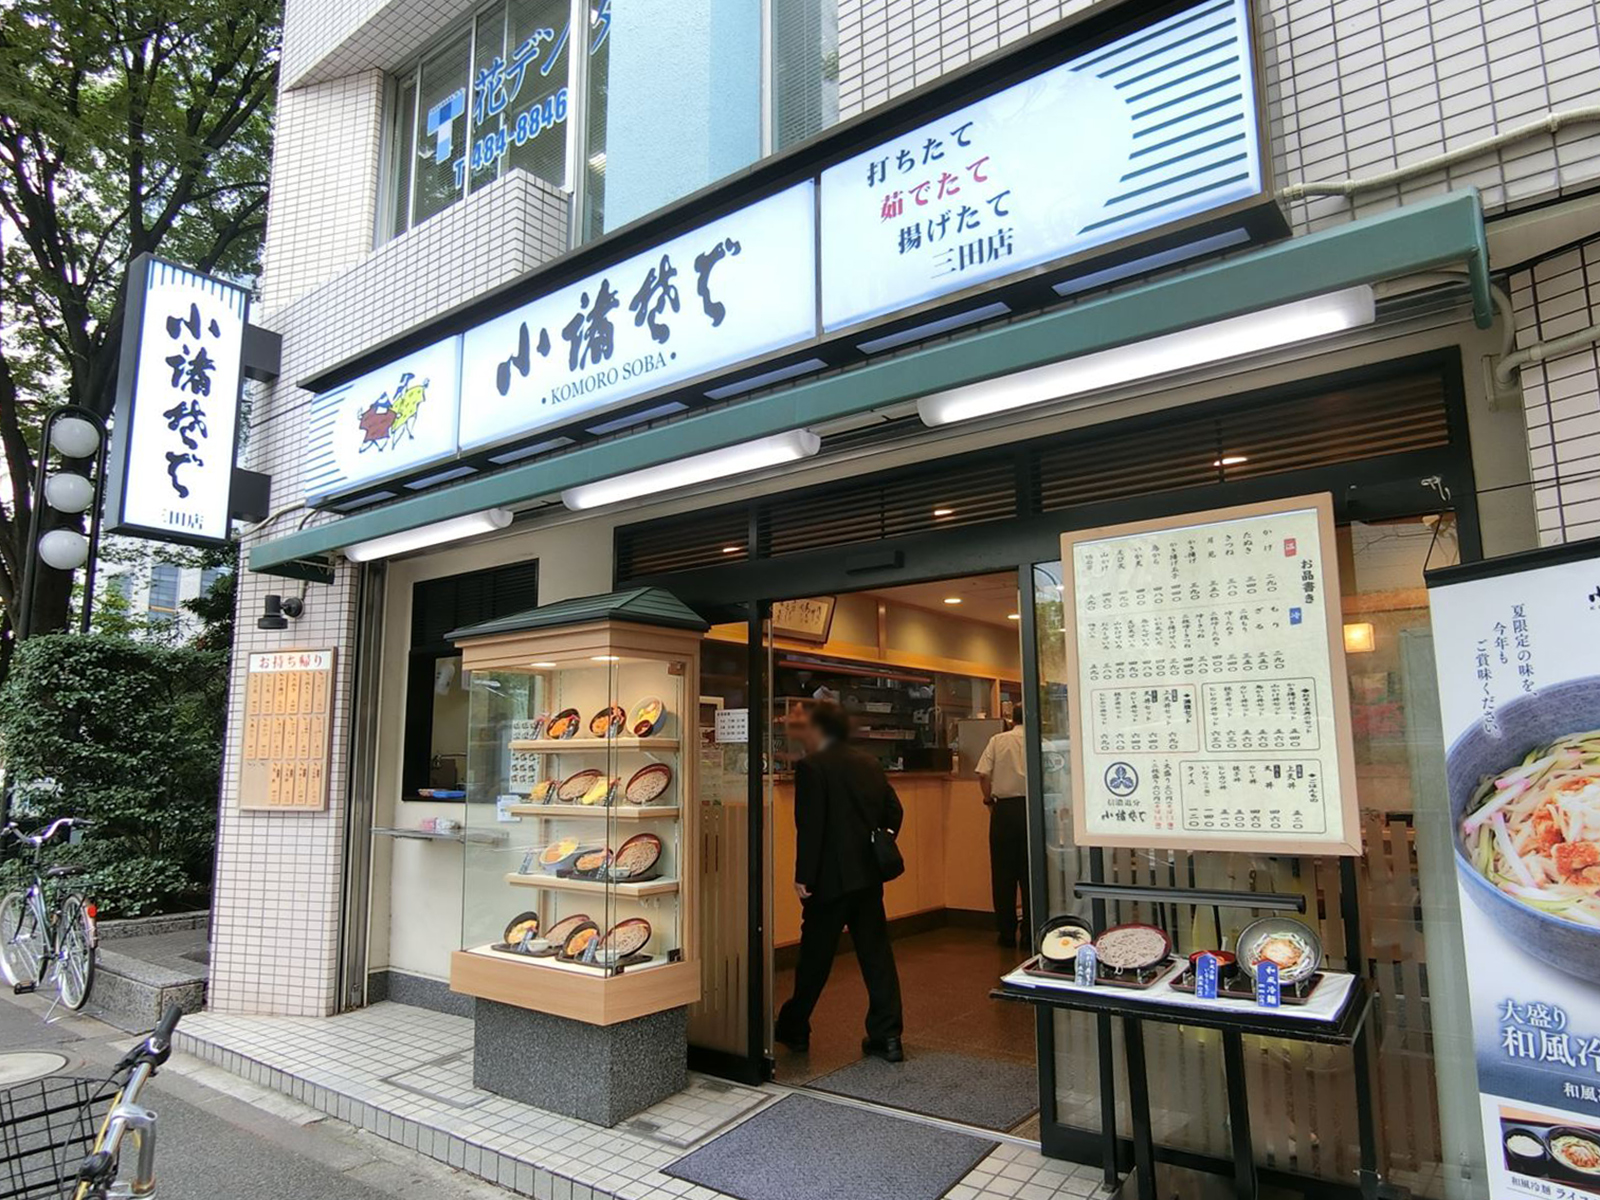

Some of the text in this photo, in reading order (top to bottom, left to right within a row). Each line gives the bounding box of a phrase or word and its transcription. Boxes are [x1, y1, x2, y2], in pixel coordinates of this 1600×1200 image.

[867, 121, 973, 188] 打ちたて
[880, 156, 990, 224] 茹でたて
[898, 190, 1011, 255] 揚げたて
[930, 228, 1014, 279] 三田店
[551, 352, 667, 405] KOMORO SOBA
[1185, 539, 1196, 563] かき揚げ
[1224, 534, 1234, 555] きつね
[1242, 531, 1253, 554] たぬき
[1262, 529, 1272, 551] かけ
[1300, 558, 1316, 604] お品書き
[259, 654, 324, 670] お持ち帰り
[1492, 621, 1511, 665] 今年も
[1511, 604, 1538, 697] 夏限定の味を、
[1187, 765, 1195, 785] ライス
[1265, 965, 1278, 1004] 和風冷麺
[1498, 999, 1566, 1031] 大盛り
[1563, 1082, 1600, 1103] 和風
